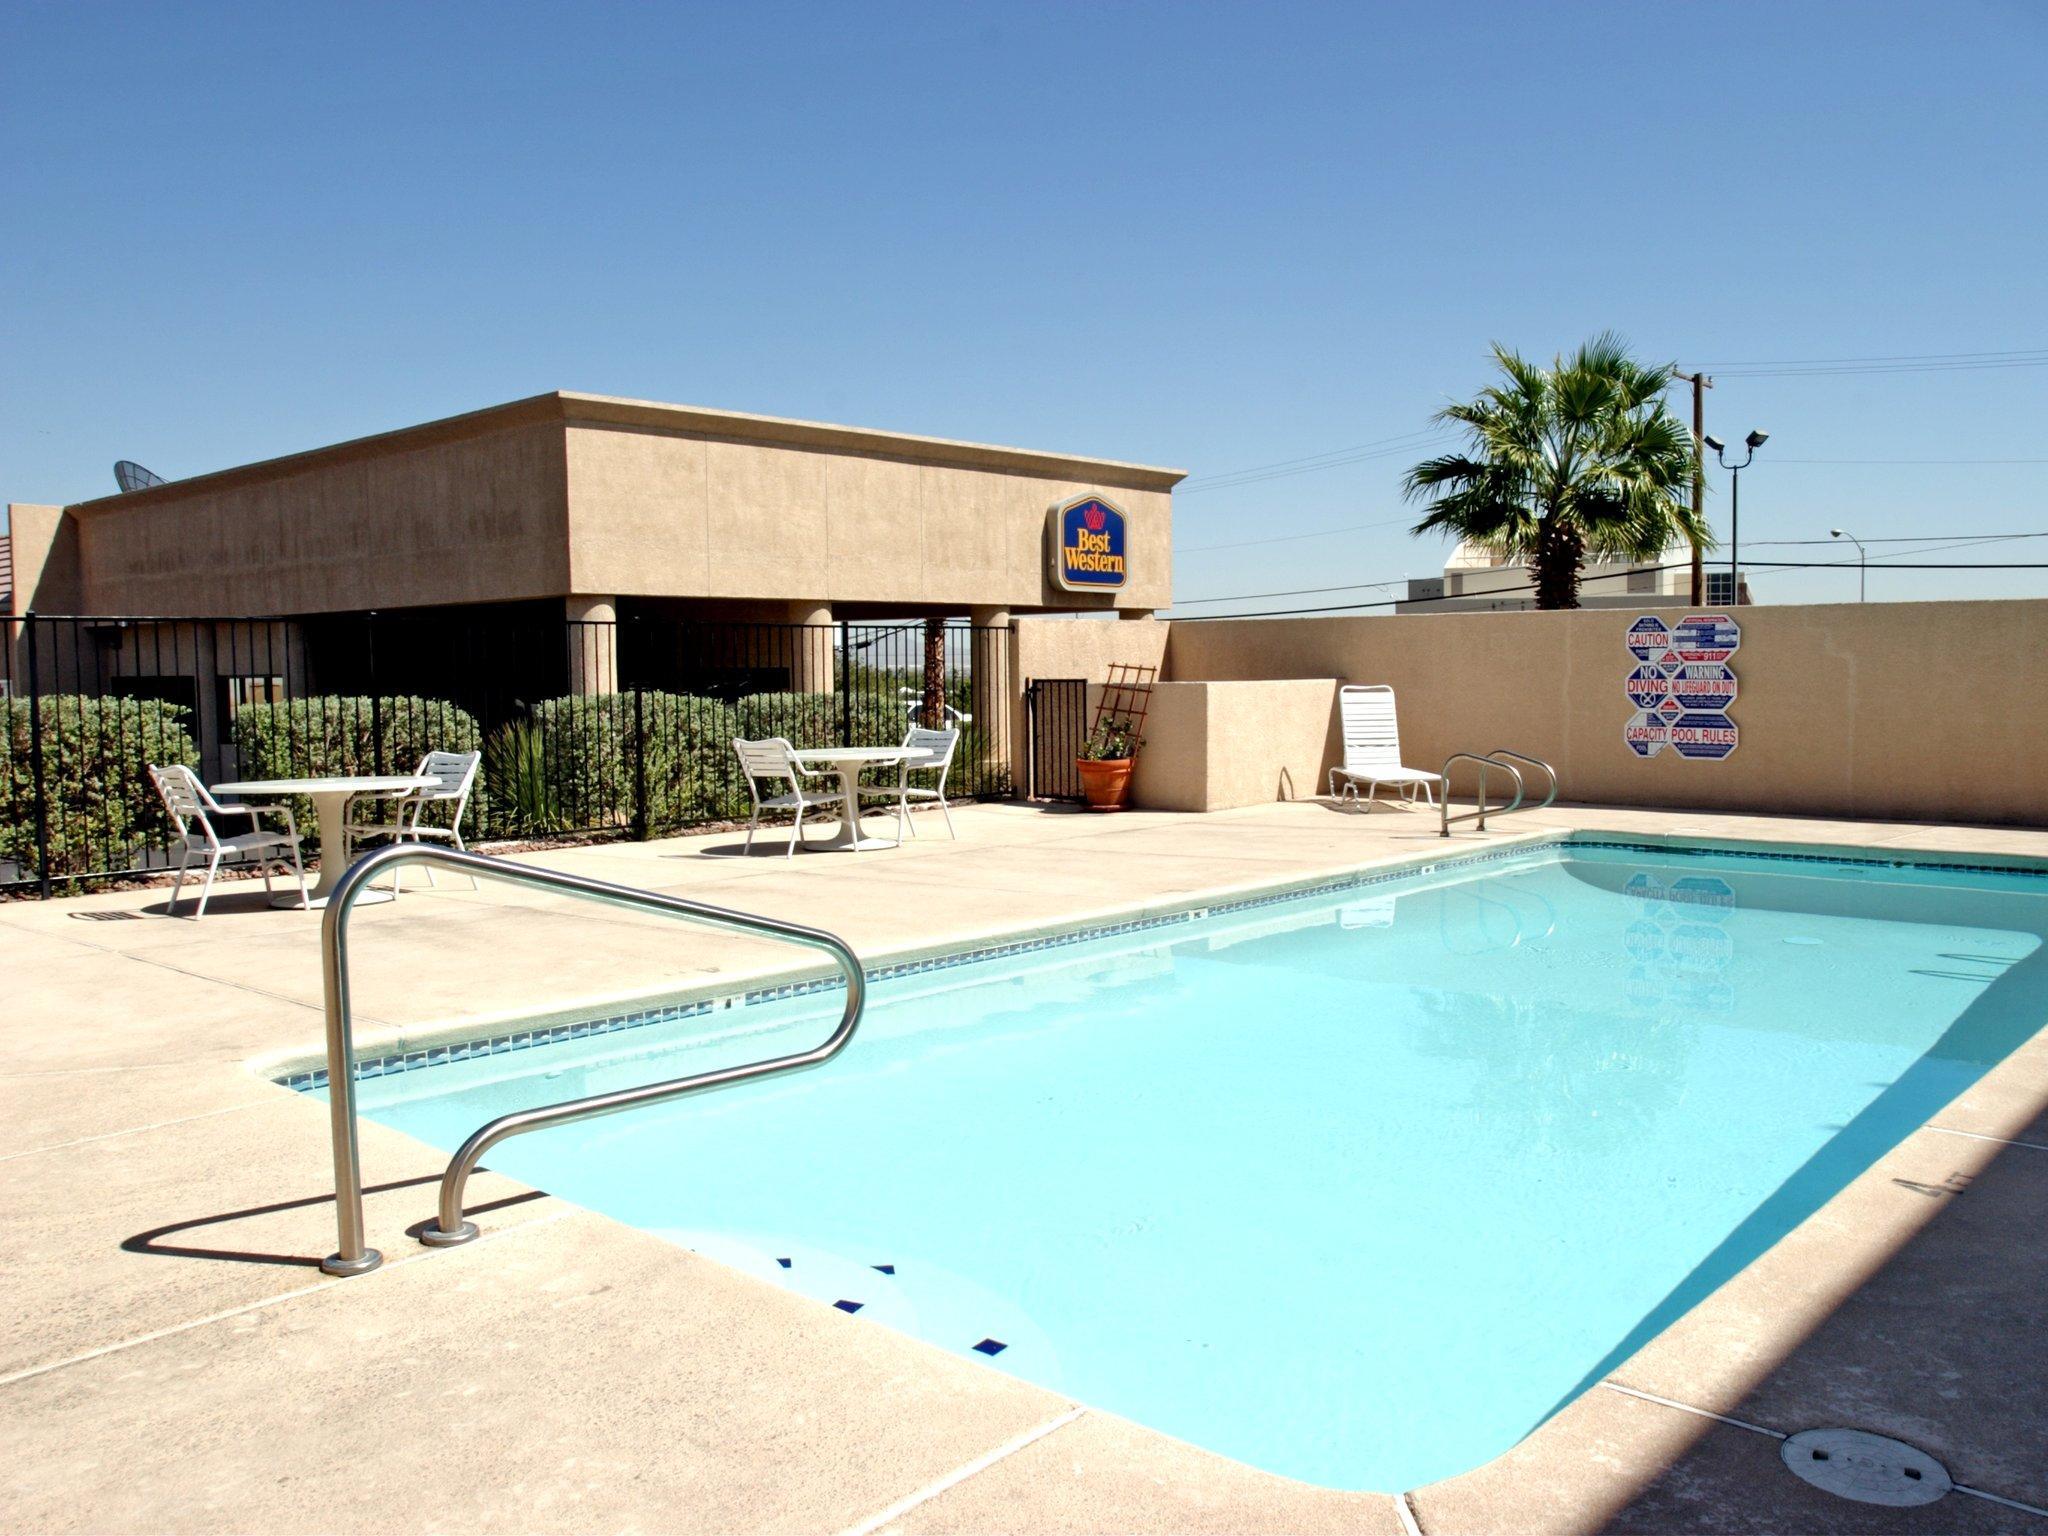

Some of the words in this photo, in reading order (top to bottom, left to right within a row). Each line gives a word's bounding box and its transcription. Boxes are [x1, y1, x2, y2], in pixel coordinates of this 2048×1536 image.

[1077, 527, 1111, 552] Best
[1064, 546, 1124, 573] Western
[1628, 633, 1669, 646] CAUTION
[1703, 652, 1716, 661] 911
[1640, 666, 1657, 679] NO
[1685, 666, 1725, 680] WARNING
[1627, 680, 1668, 693] DIVING
[1671, 682, 1681, 694] NO
[1682, 682, 1711, 694] LIFEGUARD
[1712, 682, 1721, 694] ON
[1722, 682, 1736, 694] DUTY
[1626, 727, 1668, 742] CAPACITY
[1671, 729, 1699, 742] POOL
[1703, 729, 1736, 743] RULES
